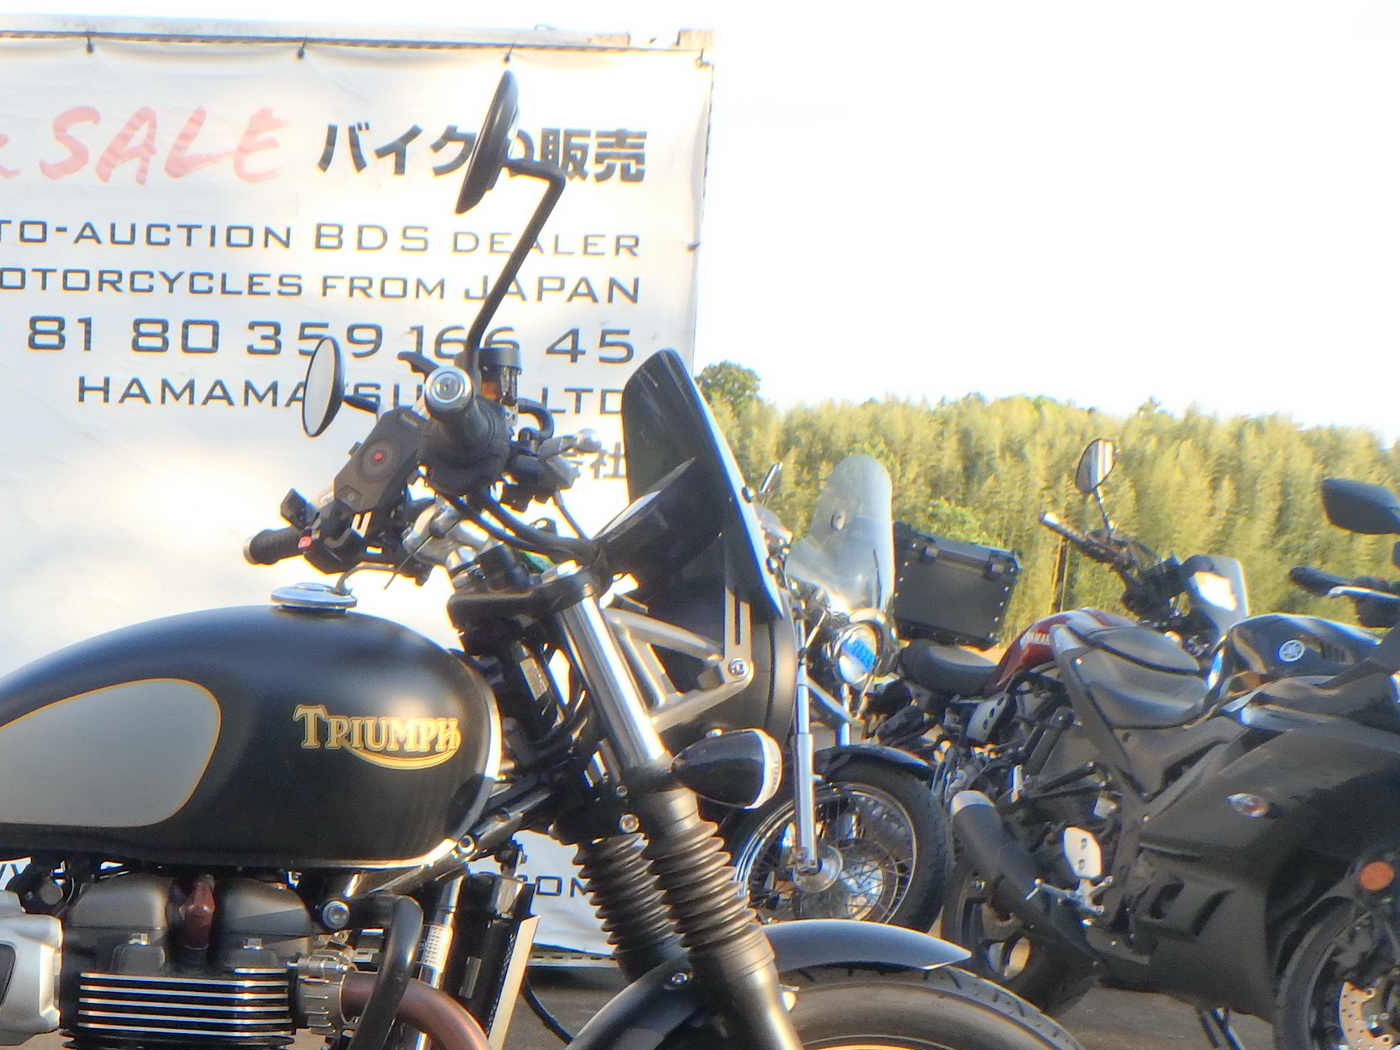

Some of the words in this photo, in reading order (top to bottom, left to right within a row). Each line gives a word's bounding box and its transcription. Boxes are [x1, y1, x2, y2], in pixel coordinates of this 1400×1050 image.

[39, 105, 289, 185] SALE
[314, 222, 430, 253] BDS
[321, 275, 445, 300] FROM
[27, 315, 93, 352] 81
[131, 318, 221, 354] 80
[545, 327, 635, 364] 45
[293, 704, 462, 770] TRIUMPH
